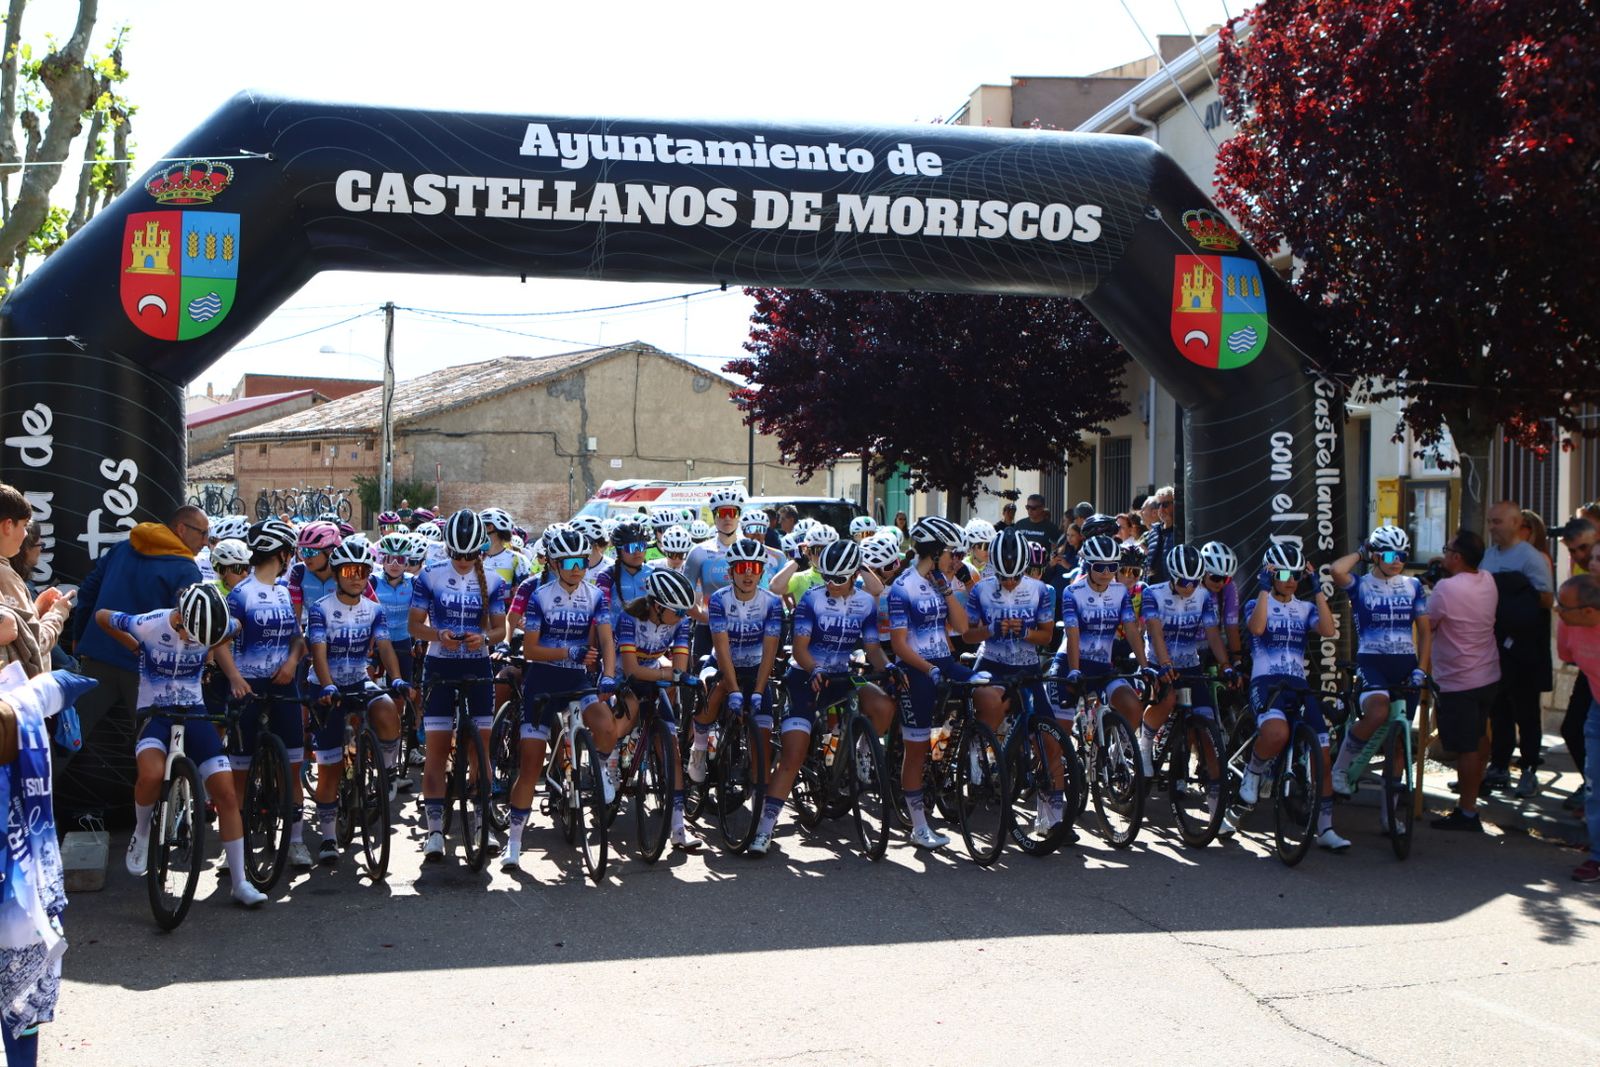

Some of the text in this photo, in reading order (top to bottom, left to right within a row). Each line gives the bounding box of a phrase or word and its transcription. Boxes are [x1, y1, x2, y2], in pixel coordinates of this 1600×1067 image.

[520, 123, 943, 177] Ayuntamiento de
[335, 170, 1102, 243] CASTELLANOS DE MORISCOS
[4, 402, 54, 467] de
[1270, 431, 1294, 481] con
[1313, 377, 1341, 551] Castellanos
[1271, 493, 1310, 522] el
